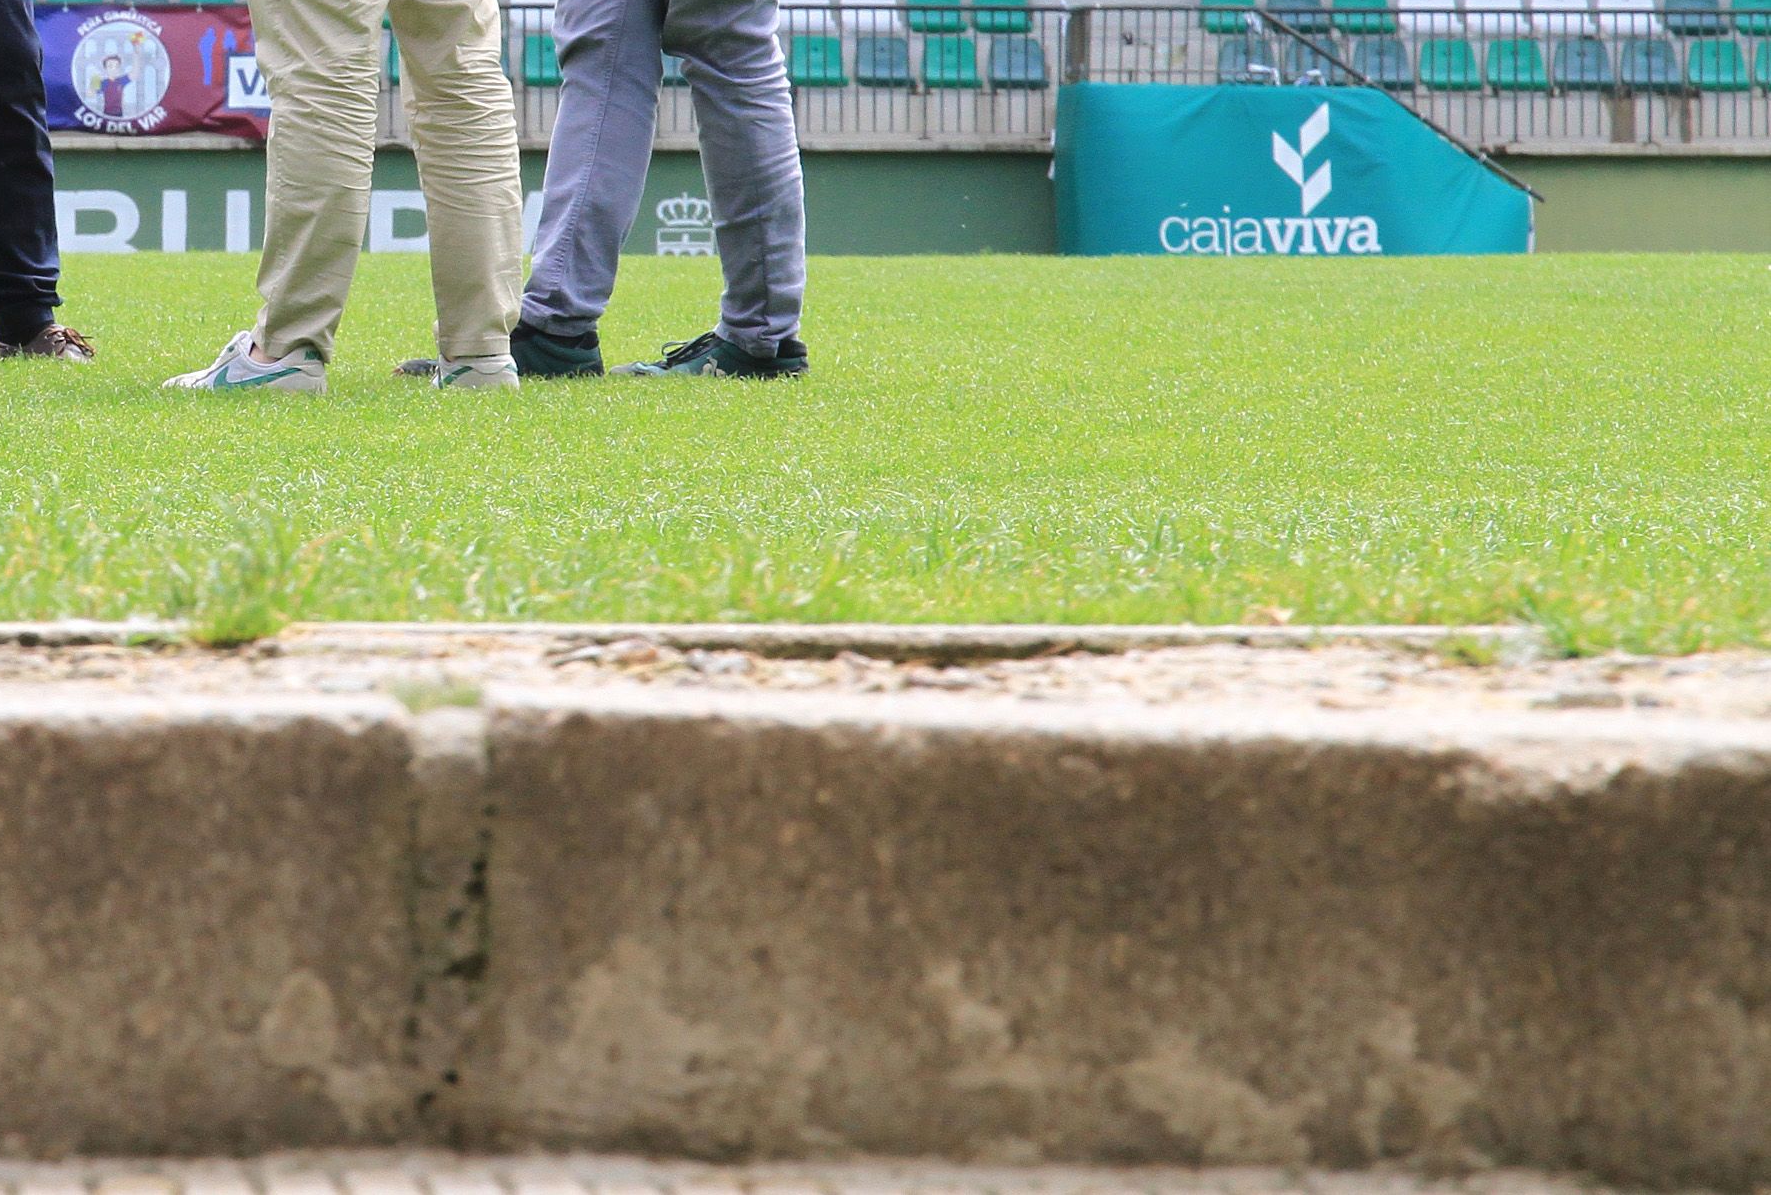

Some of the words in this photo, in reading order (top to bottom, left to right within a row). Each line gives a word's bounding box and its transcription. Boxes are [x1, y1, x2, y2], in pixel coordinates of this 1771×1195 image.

[237, 68, 268, 96] V
[74, 105, 104, 130] LOS
[137, 105, 168, 131] VAR
[1159, 205, 1382, 255] cajaviva
